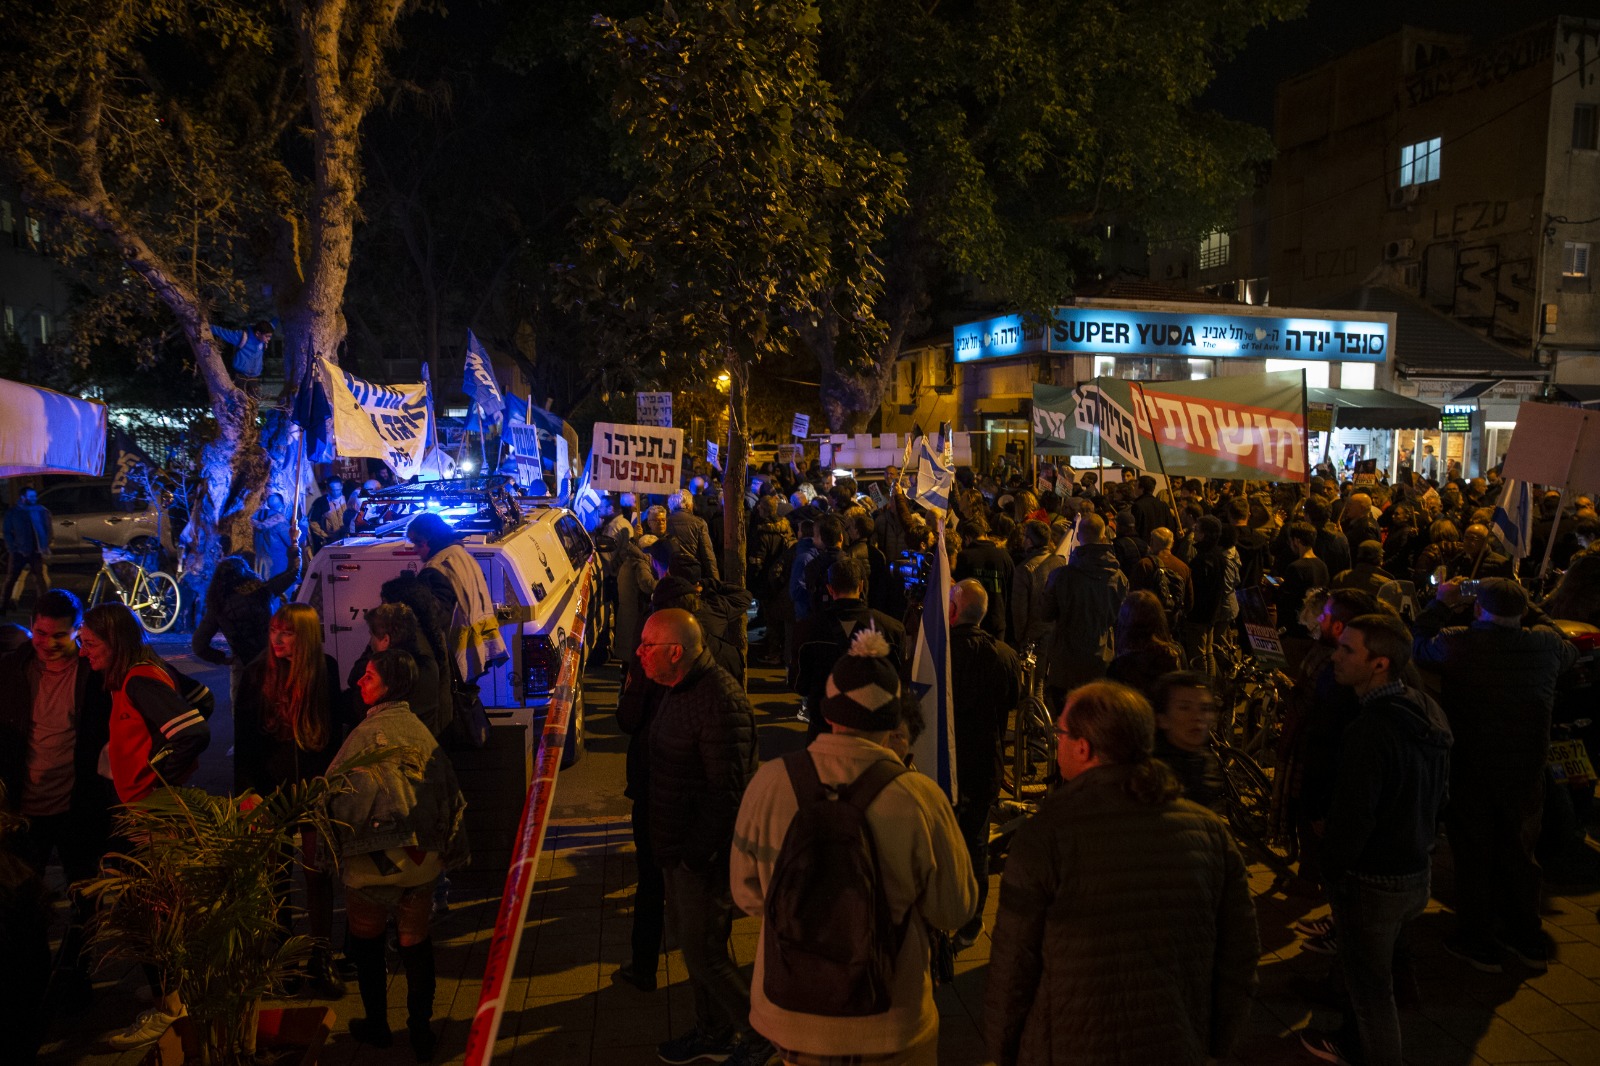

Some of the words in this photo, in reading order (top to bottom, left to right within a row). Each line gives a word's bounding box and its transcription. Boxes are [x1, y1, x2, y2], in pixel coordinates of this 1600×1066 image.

[1054, 320, 1130, 344] SUPER
[1136, 323, 1197, 346] YUDA
[1202, 326, 1228, 340] אביב
[1230, 324, 1244, 340] תל
[1285, 329, 1331, 352] יודה
[1334, 332, 1385, 354] סופר
[1203, 341, 1217, 349] The
[1242, 342, 1249, 350] of
[1251, 343, 1262, 351] Tel
[1264, 343, 1280, 351] Aviv
[1075, 383, 1140, 460] הביתה!
[1131, 383, 1306, 475] מושחתים
[604, 432, 677, 460] נתניהו
[593, 454, 675, 484] תתפטר!
